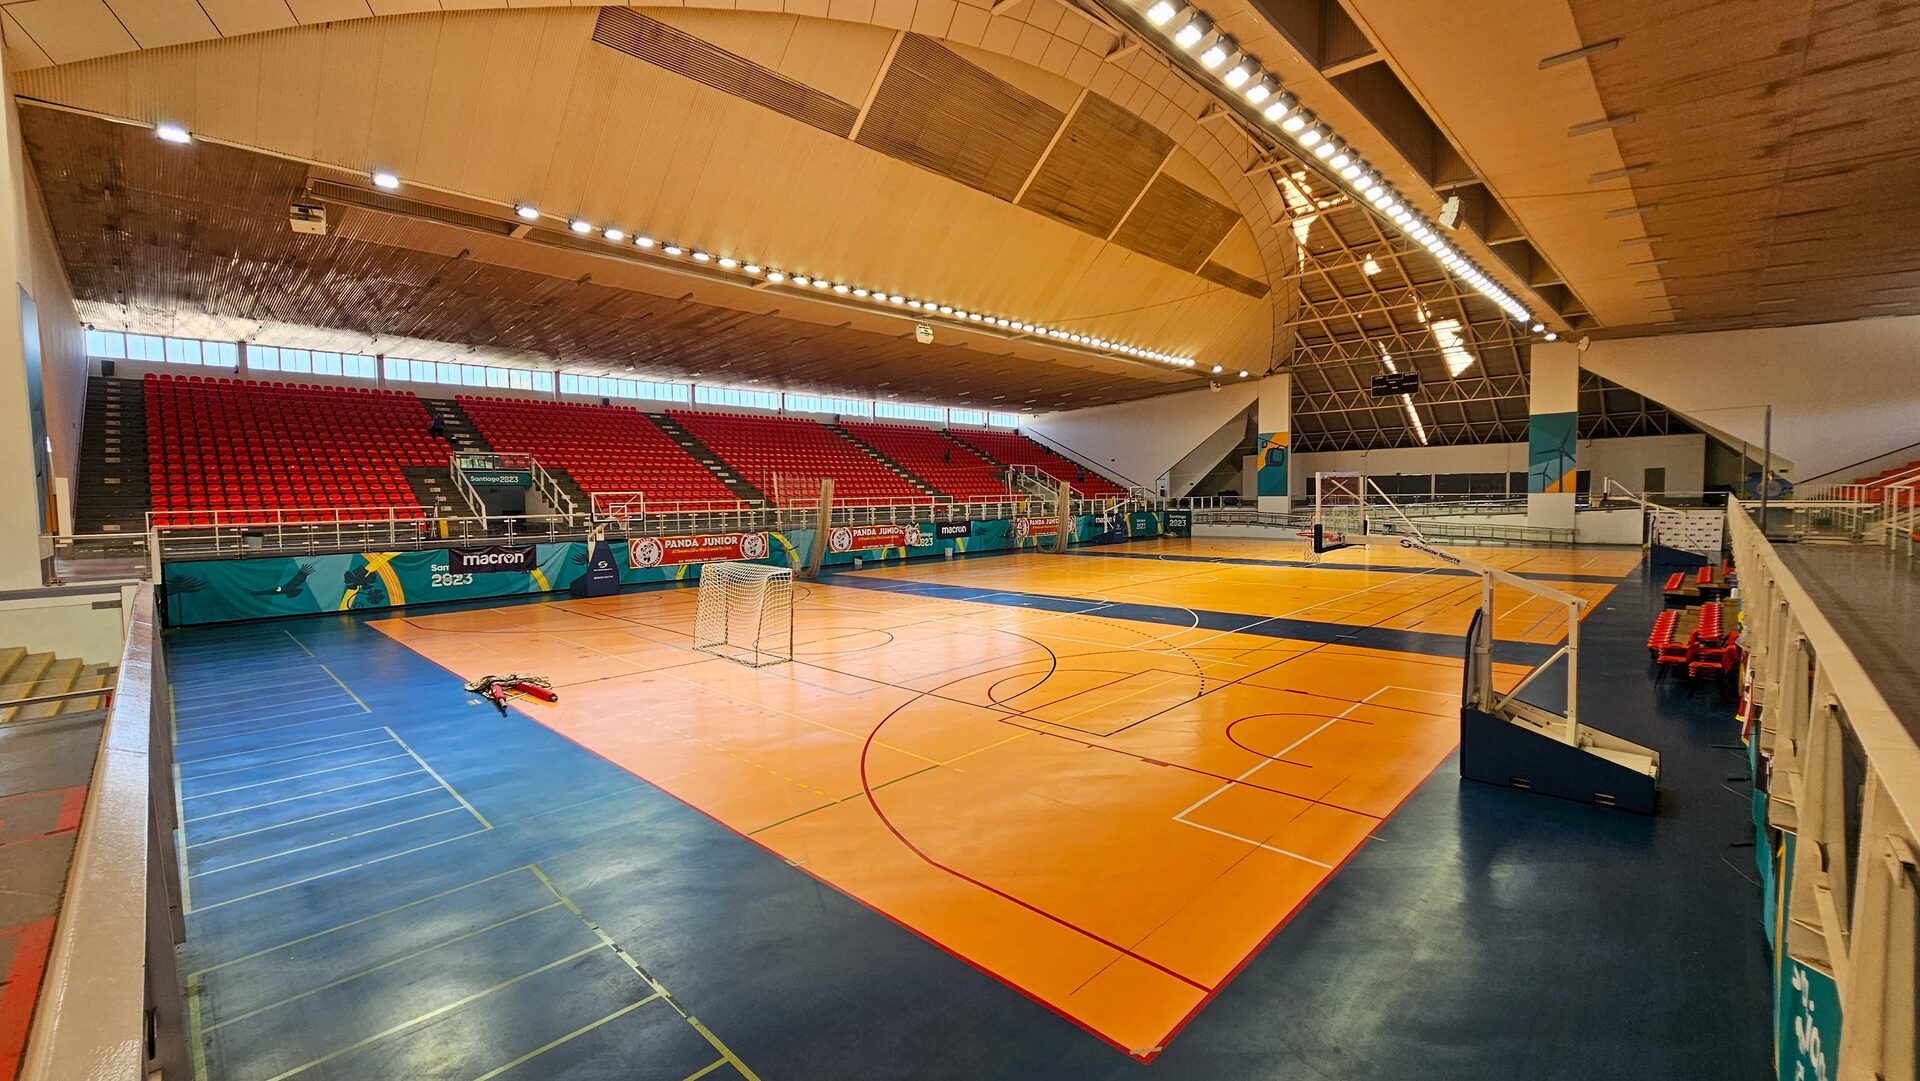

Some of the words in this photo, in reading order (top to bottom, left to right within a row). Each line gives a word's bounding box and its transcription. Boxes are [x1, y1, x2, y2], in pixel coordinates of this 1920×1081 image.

[470, 475, 499, 483] Santiago
[499, 475, 519, 483] 2023
[1169, 519, 1187, 527] 2023
[853, 528, 877, 537] PANDA
[941, 525, 967, 535] macron
[664, 538, 699, 549] PANDA
[702, 536, 738, 547] JUNIOR
[463, 552, 524, 566] macron
[1439, 552, 1461, 564] Sports
[431, 573, 473, 588] 2023
